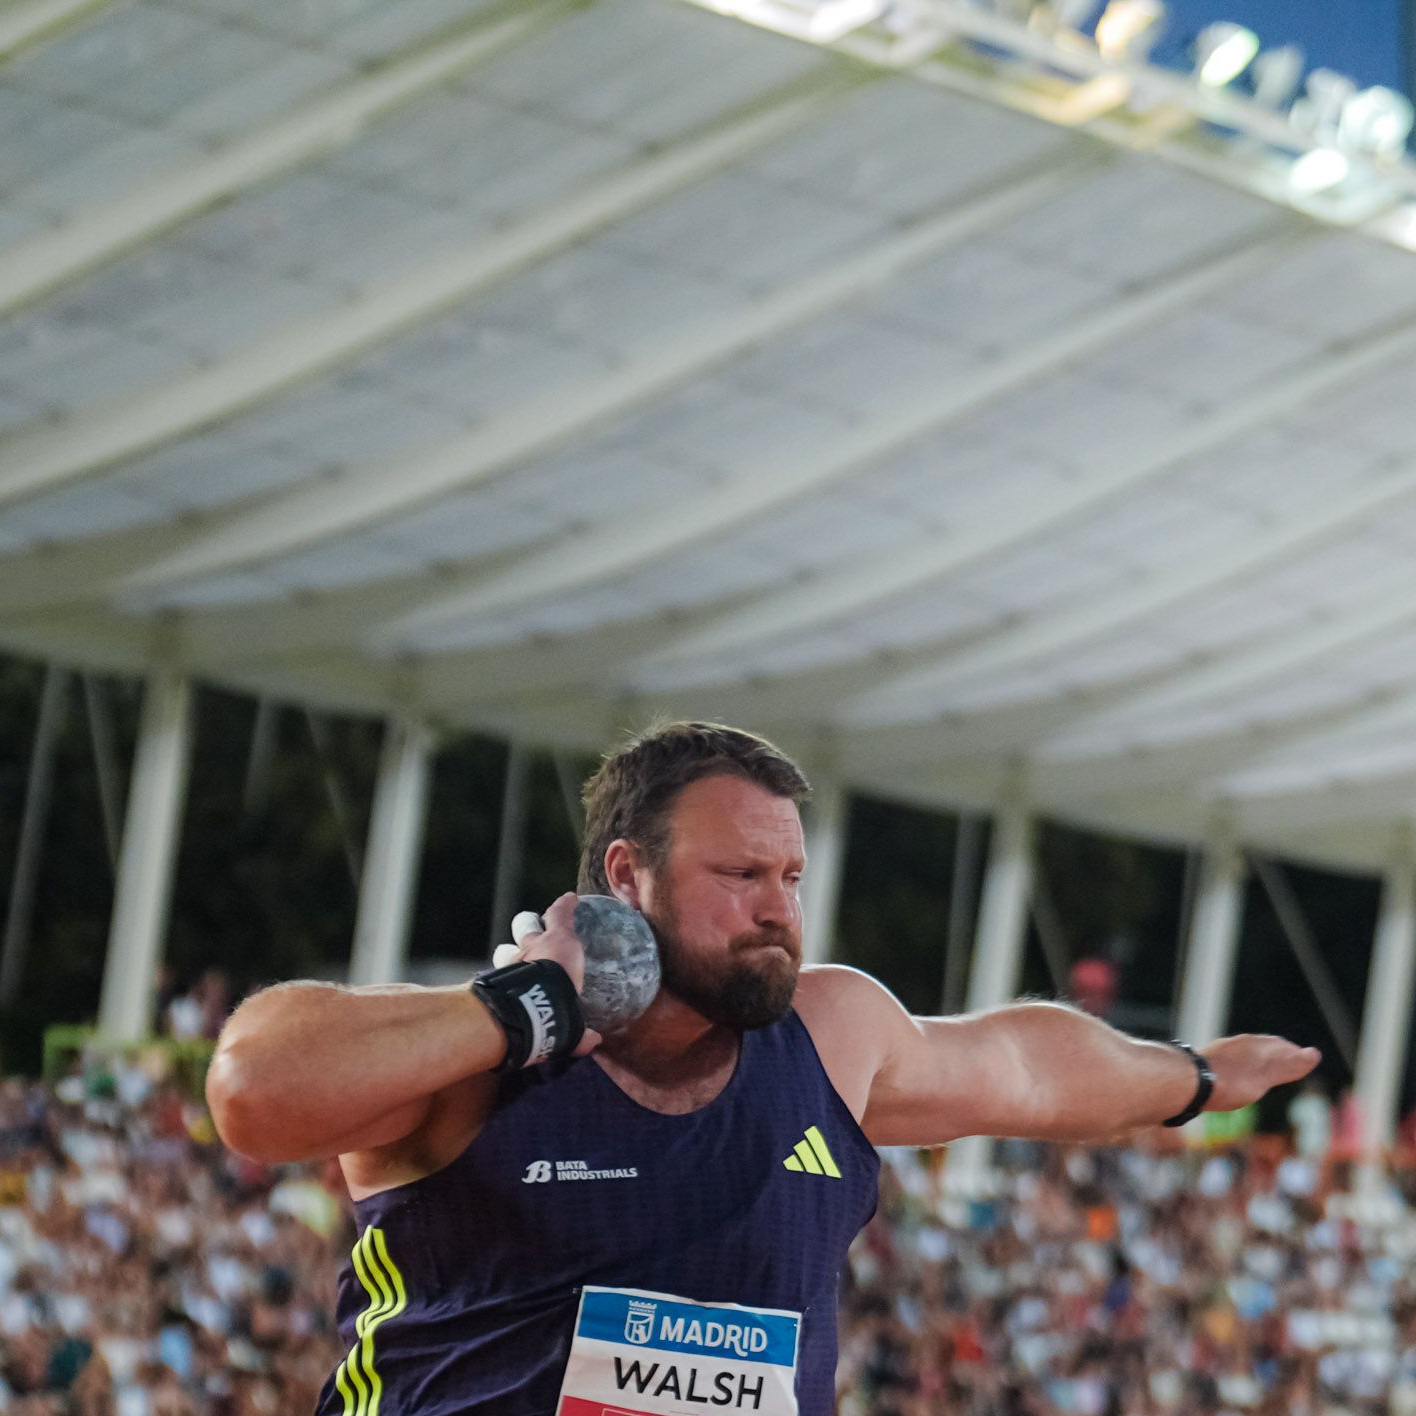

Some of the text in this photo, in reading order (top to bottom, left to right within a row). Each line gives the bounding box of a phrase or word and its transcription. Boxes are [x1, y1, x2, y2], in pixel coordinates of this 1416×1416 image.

[555, 1160, 588, 1171] BATA
[557, 1167, 639, 1181] INDUSTRIALS
[659, 1315, 768, 1357] MADRID
[614, 1356, 764, 1410] WALSH
